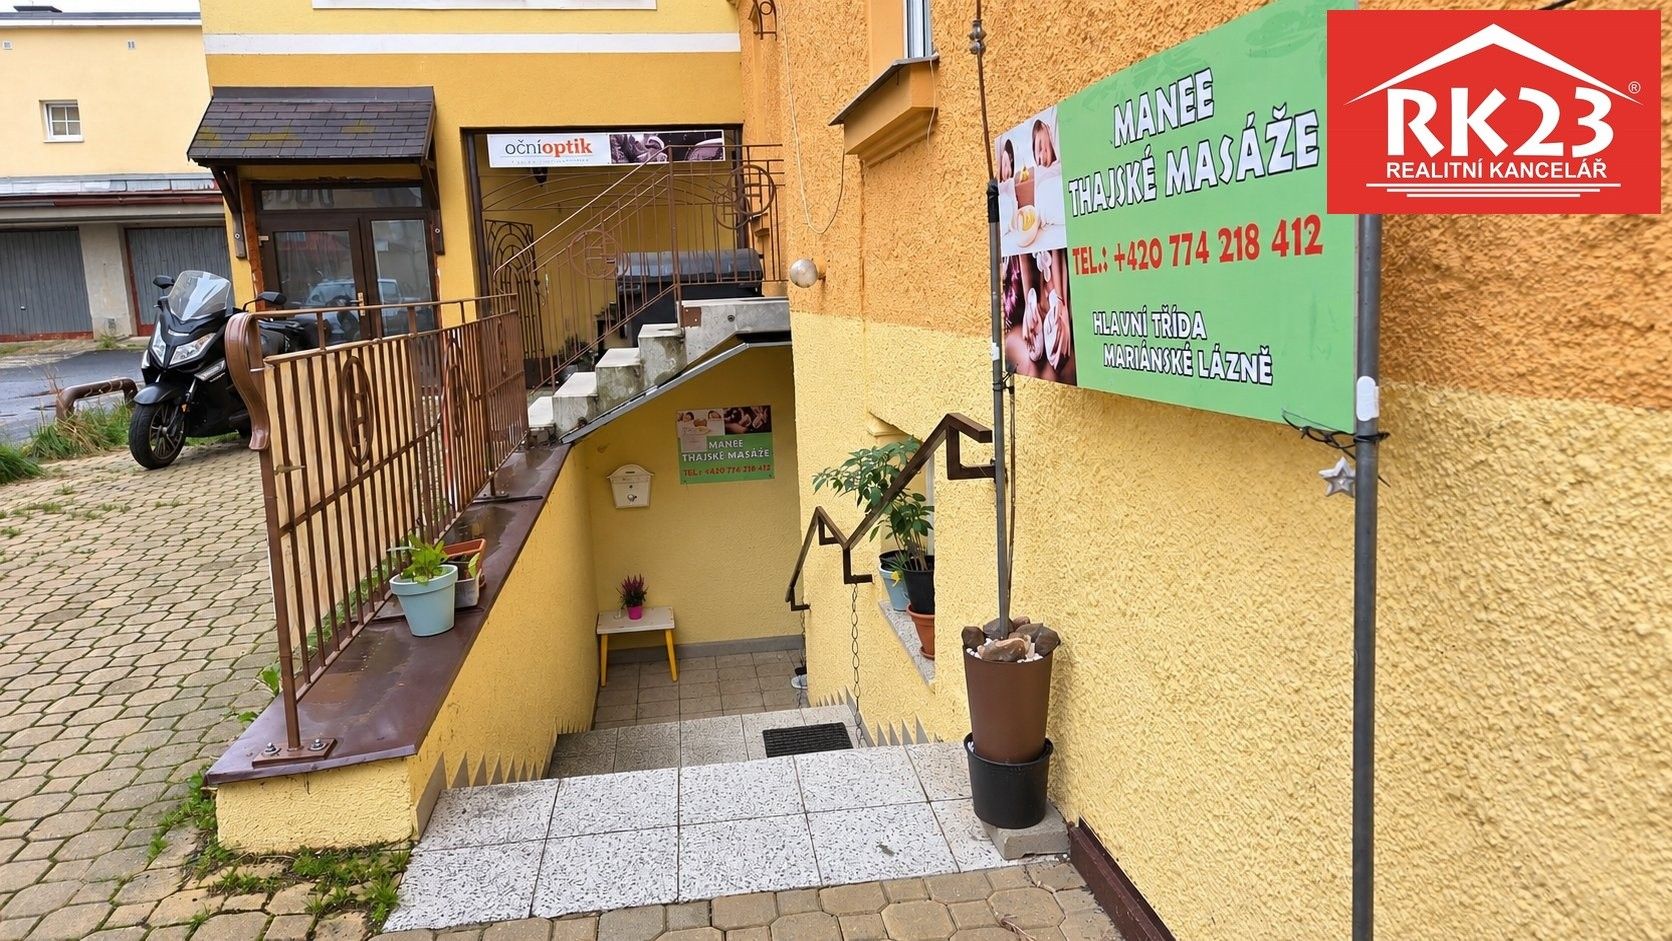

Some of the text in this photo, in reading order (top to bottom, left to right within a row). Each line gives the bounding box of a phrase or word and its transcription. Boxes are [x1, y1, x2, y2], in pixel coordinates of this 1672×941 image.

[1113, 67, 1214, 148] MANEE
[505, 137, 592, 157] očníoptik
[1068, 102, 1319, 217] THAJSKÉ MASÁŽE
[1072, 214, 1324, 275] TEL.: +420 774 218 412
[1092, 305, 1208, 341] HLAVNÍ TŘÍDA
[1103, 339, 1274, 386] MARIÁNSKÉ LÁZNĚ
[682, 447, 769, 462] THAJSKÉ MASÁŽE
[708, 439, 744, 449] MANEE
